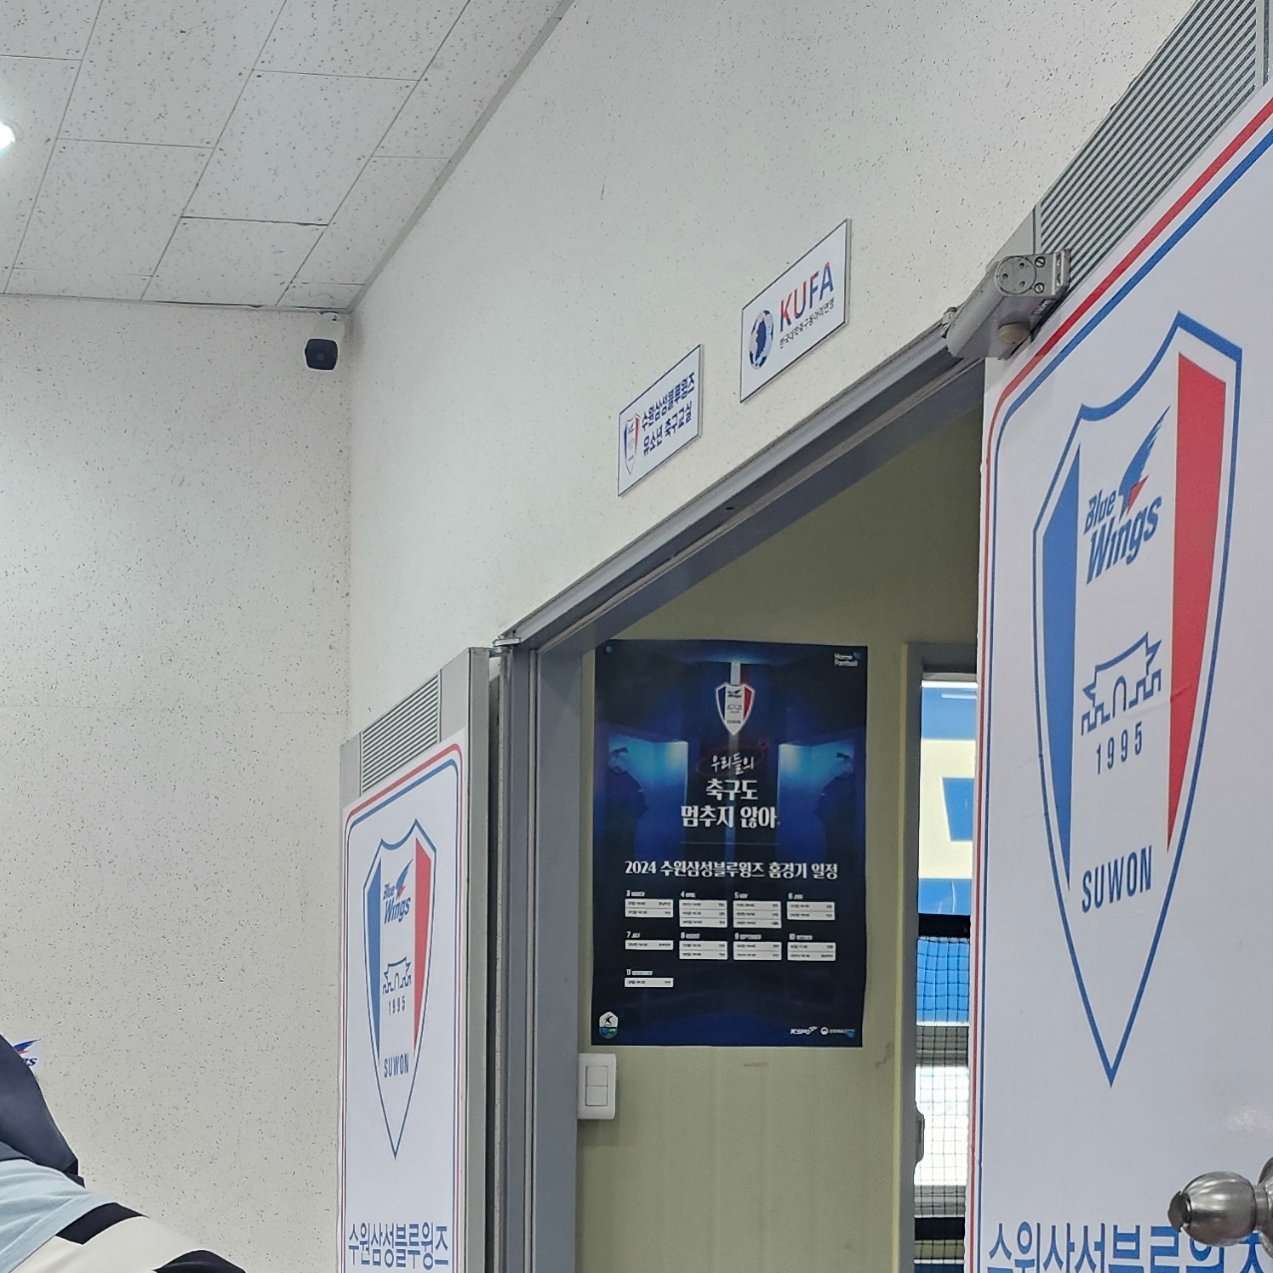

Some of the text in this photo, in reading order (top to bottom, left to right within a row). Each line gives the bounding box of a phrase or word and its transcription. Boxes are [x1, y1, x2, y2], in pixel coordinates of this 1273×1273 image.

[780, 262, 834, 333] KUFA
[641, 371, 695, 431] 수원삼성블루윙즈
[643, 424, 663, 457] 유소년
[665, 401, 693, 438] 축구교실
[1083, 489, 1117, 535] Blue
[1086, 496, 1162, 585] Wings
[710, 752, 754, 776] 우리들의
[1096, 721, 1143, 775] 1995
[705, 778, 758, 800] 축구도
[681, 805, 734, 828] 멈추지
[625, 860, 838, 880] 2024 수원삼성블루윙즈 홈경기 일정
[1082, 845, 1152, 913] SUWON
[383, 882, 396, 900] Blue
[384, 897, 411, 924] Wings
[388, 999, 406, 1016] 1995
[383, 1053, 409, 1079] SUWON
[348, 1222, 448, 1270] 수원삼성블루윙즈
